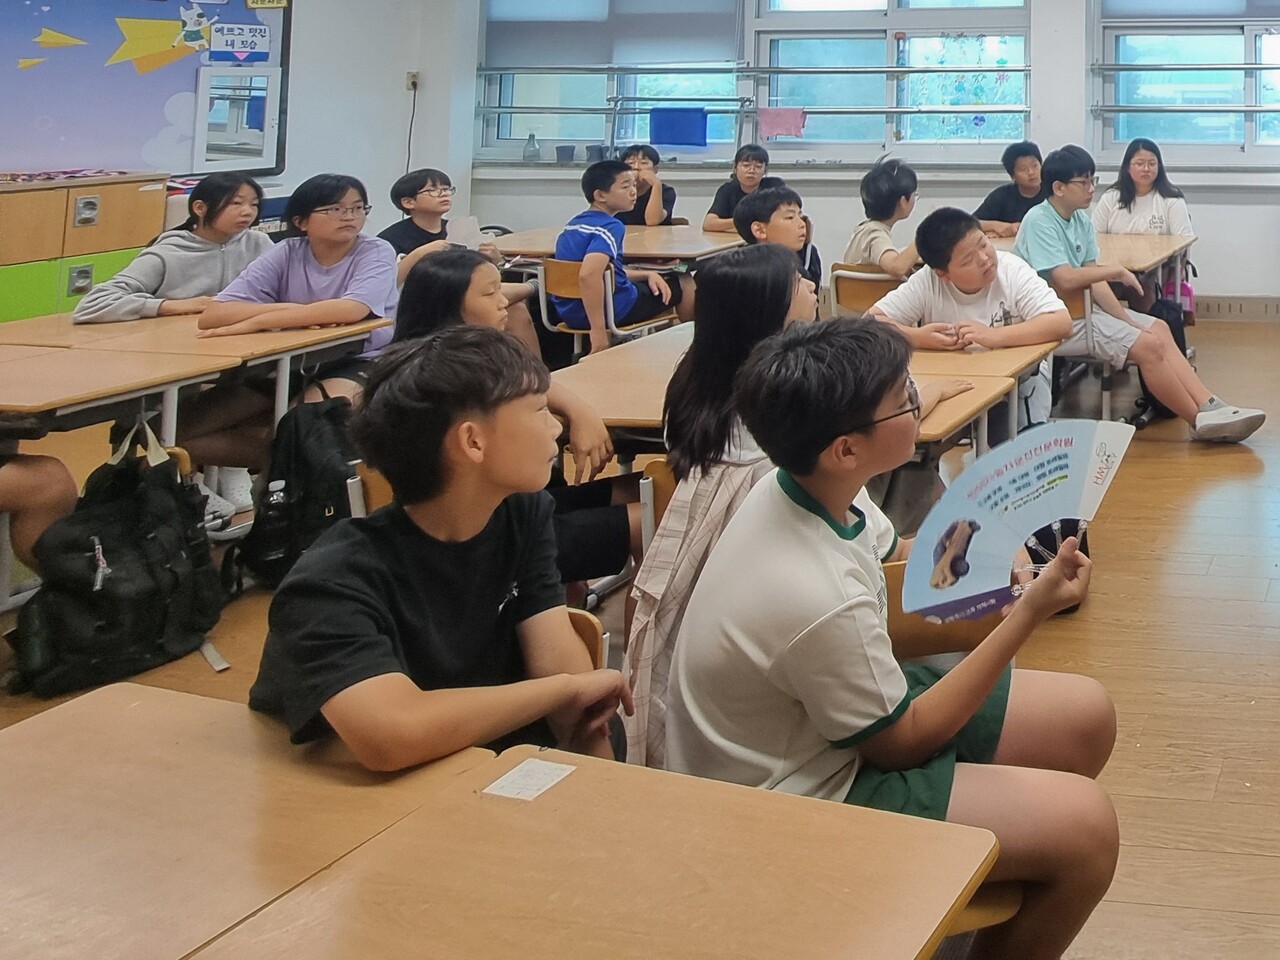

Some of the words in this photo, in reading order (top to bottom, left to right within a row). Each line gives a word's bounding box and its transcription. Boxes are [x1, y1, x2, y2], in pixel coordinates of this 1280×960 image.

[248, 27, 267, 38] 멋진
[225, 39, 235, 49] 내
[239, 40, 258, 50] 모습
